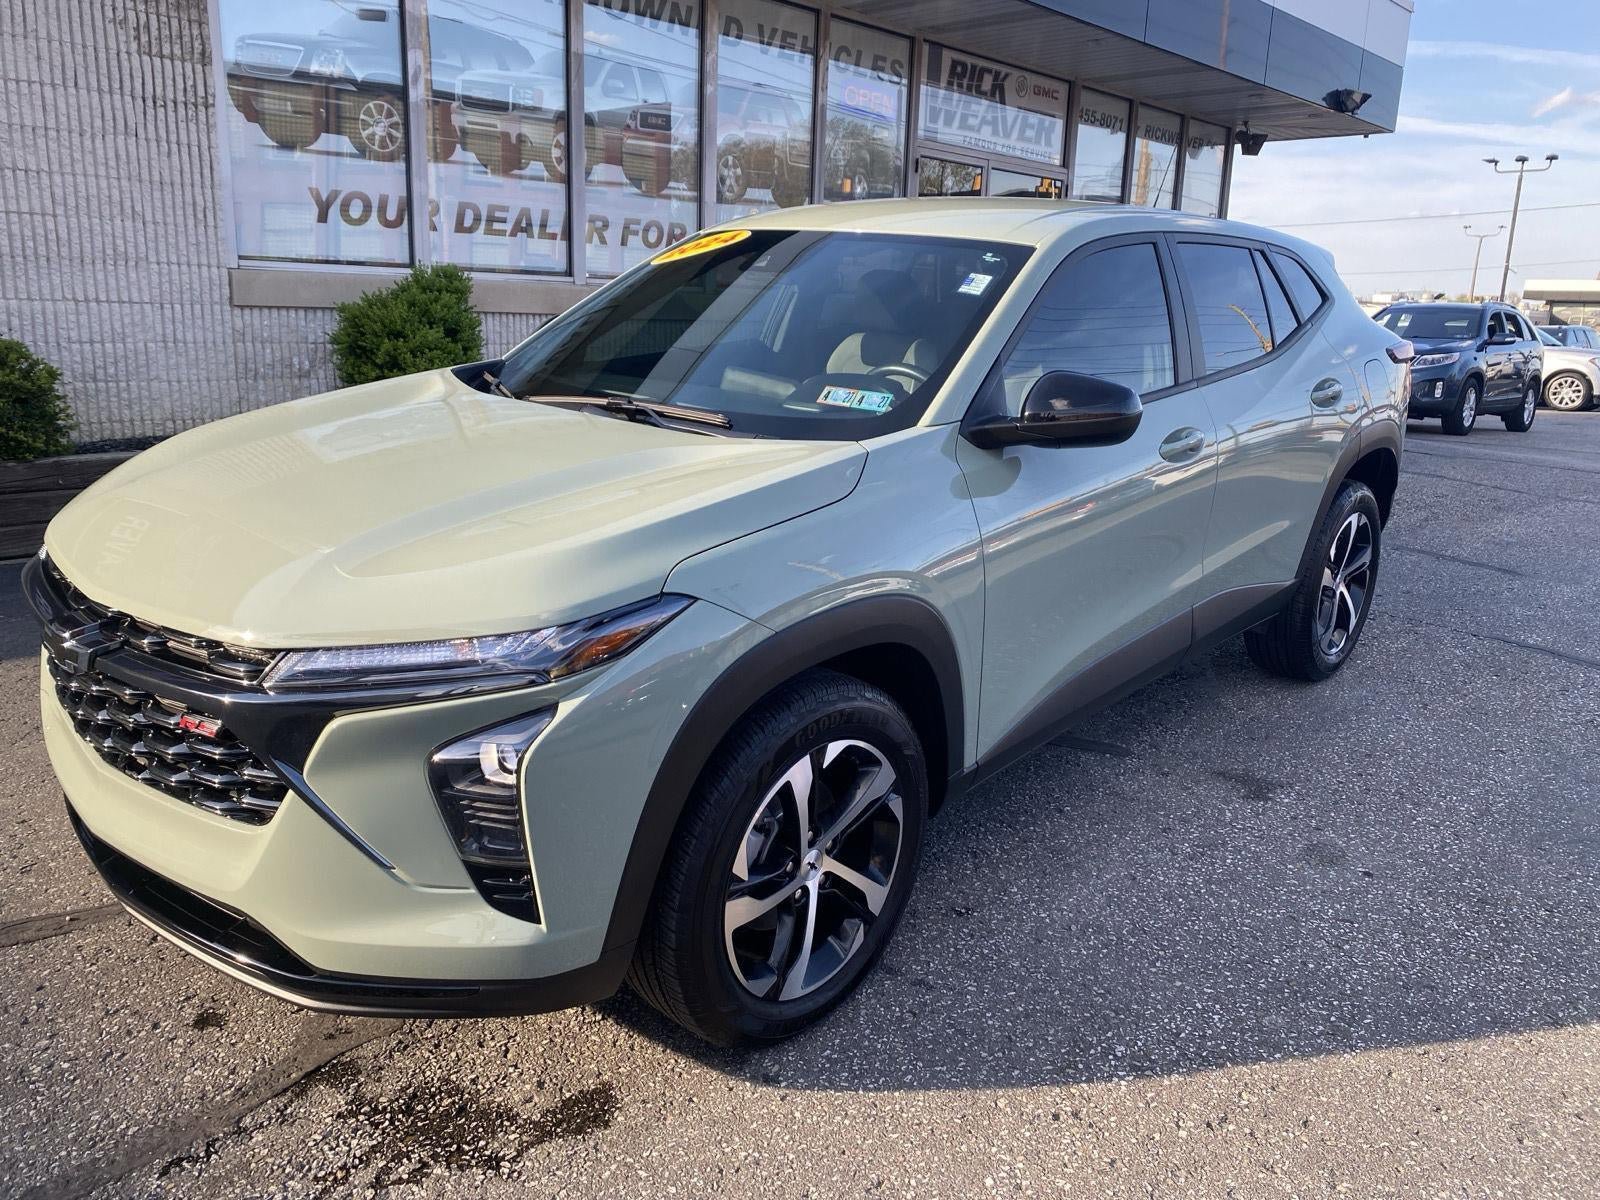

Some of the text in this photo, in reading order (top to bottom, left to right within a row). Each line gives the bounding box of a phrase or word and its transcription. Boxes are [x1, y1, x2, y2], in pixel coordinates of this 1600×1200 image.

[946, 58, 1010, 105] RICK
[1032, 84, 1060, 101] GMC
[844, 85, 895, 114] OPEN
[928, 92, 1057, 147] WEAVER
[961, 135, 997, 151] FAMOUS
[1001, 142, 1016, 153] FOR
[877, 396, 890, 408] 27
